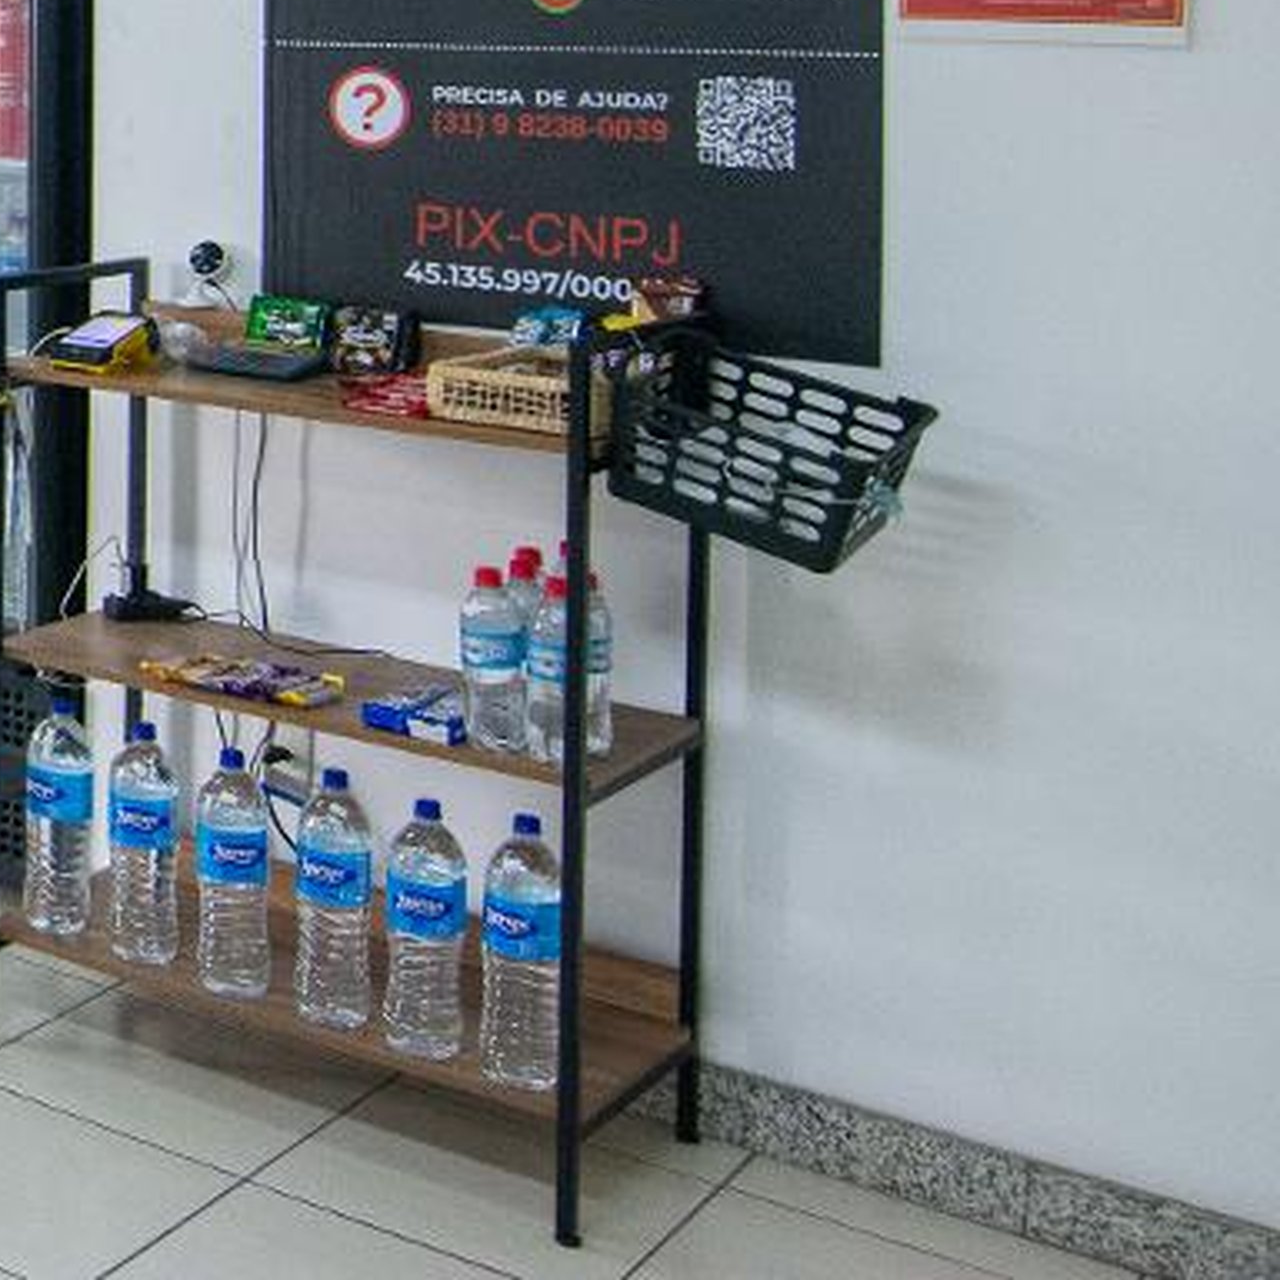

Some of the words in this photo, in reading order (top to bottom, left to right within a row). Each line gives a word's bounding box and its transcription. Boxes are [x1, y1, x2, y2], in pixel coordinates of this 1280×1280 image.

[432, 85, 524, 106] PRECISA
[536, 88, 567, 108] DE
[577, 90, 668, 111] AJUDA?
[432, 108, 486, 141] (31)
[494, 113, 509, 136] 9
[415, 204, 683, 266] PIX-CNPJ
[403, 261, 634, 303] 45.135.997/000
